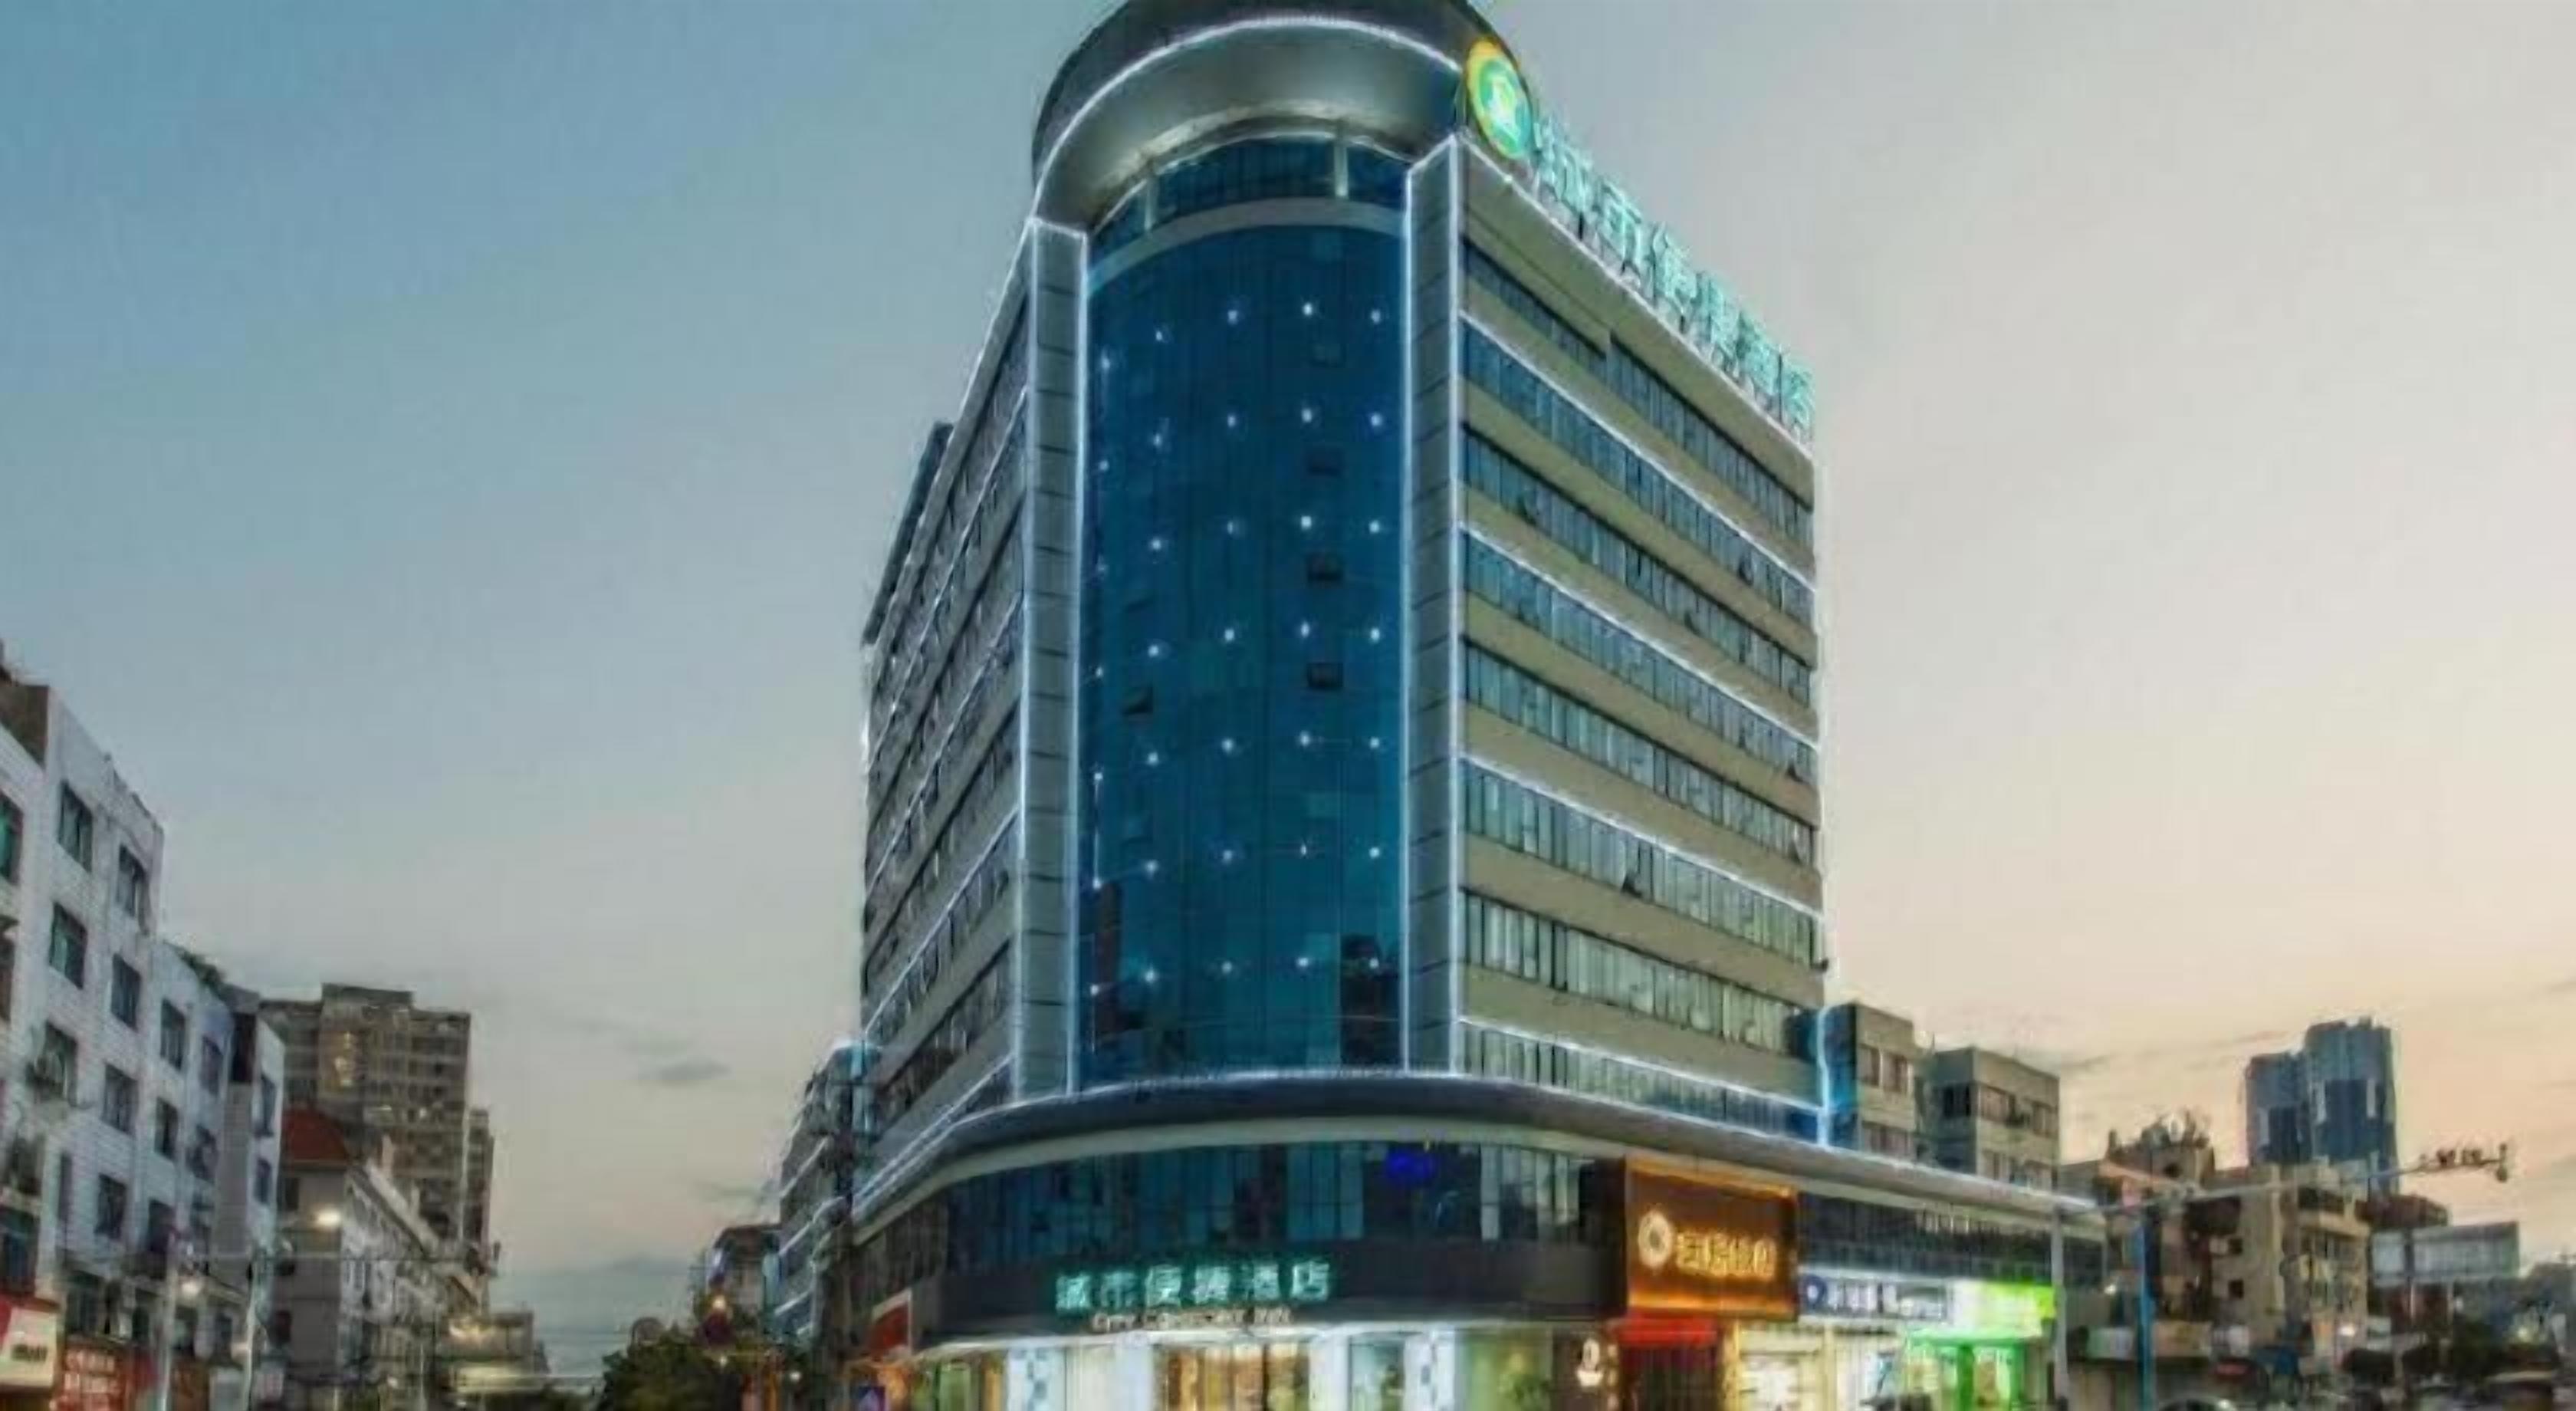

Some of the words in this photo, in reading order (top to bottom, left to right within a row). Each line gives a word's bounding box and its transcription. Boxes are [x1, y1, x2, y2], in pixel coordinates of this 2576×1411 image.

[1056, 1261, 1330, 1311] 城市便捷酒店
